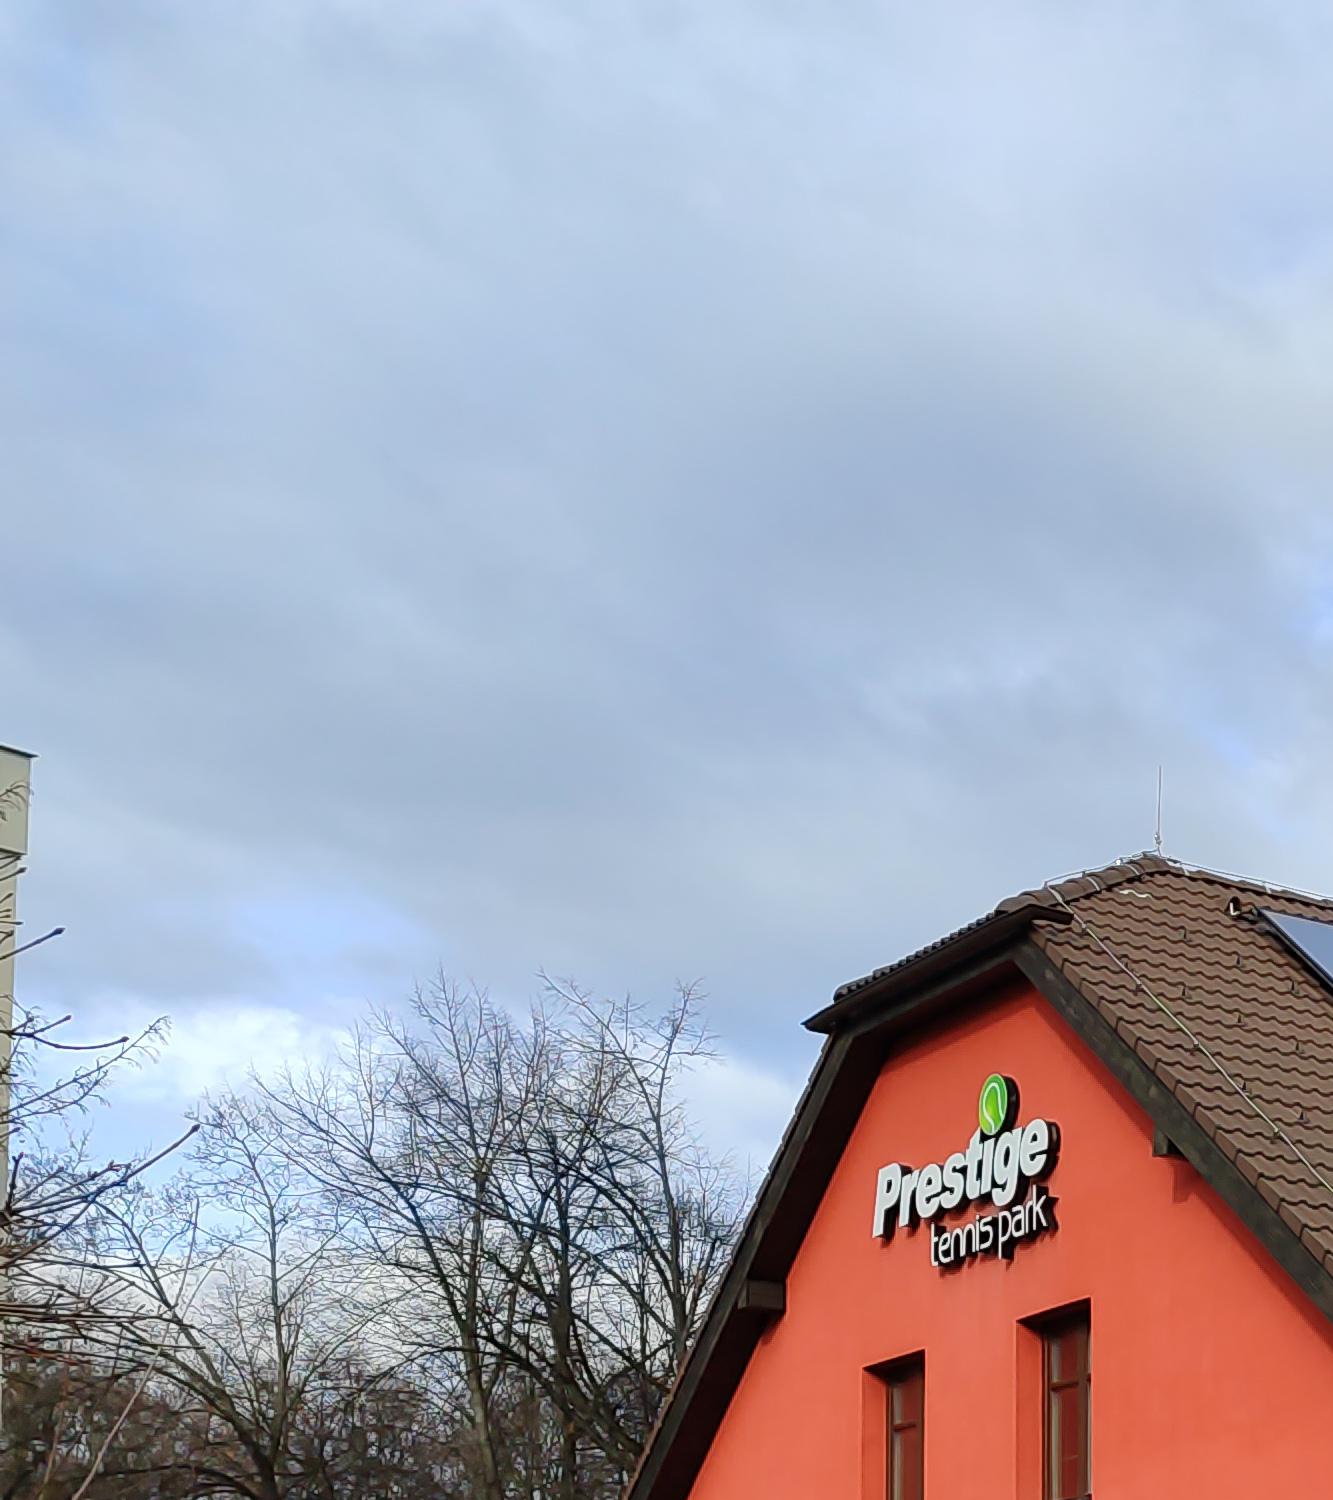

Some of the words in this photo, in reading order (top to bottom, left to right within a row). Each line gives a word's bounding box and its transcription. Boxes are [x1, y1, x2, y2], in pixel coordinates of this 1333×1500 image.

[872, 1116, 1049, 1239] Prestige
[930, 1213, 993, 1267] tennis
[998, 1184, 1048, 1260] park
